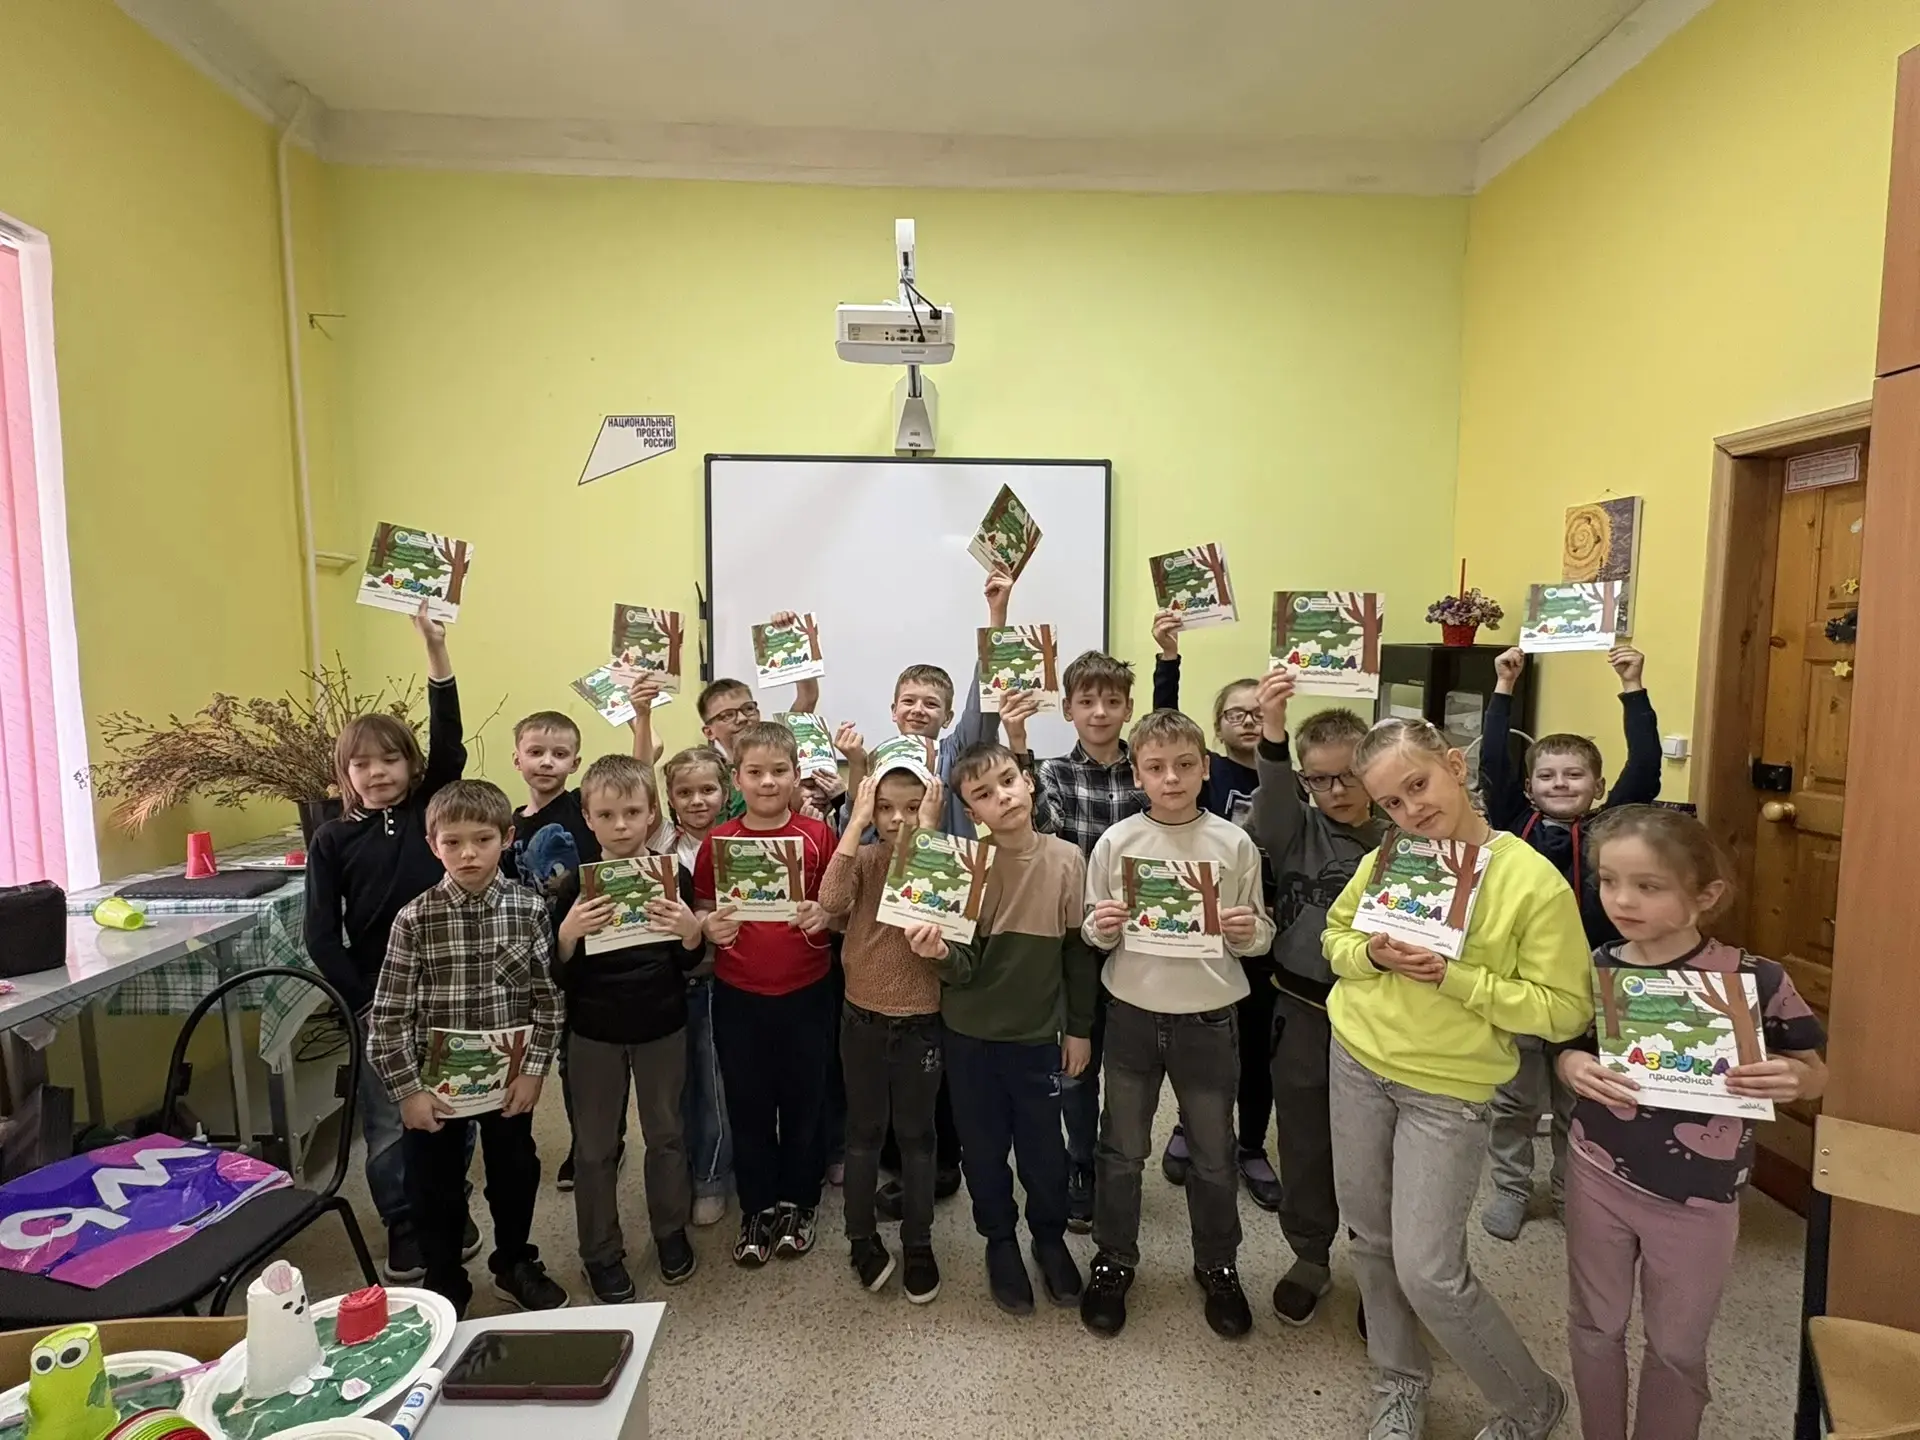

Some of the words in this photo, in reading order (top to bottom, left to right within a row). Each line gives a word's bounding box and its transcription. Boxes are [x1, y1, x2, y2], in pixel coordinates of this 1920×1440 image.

[608, 417, 673, 428] НАЦИОНАЛЬНЫЕ
[636, 428, 673, 438] ПРОЕКТЫ
[643, 438, 673, 448] РОССИИ
[381, 573, 442, 598] АЗБУКА
[1170, 594, 1218, 611] АЗБУКА
[1287, 651, 1357, 670] АЗБУКА
[991, 676, 1042, 691] АЗБУКА
[730, 887, 787, 901] АЗБУКА
[900, 885, 961, 914] АЗБУКА
[1376, 891, 1443, 921] АЗБУКА
[1139, 914, 1201, 934] АЗБУКА
[1627, 1047, 1730, 1077] АЗБУКА
[1648, 1072, 1715, 1086] природная
[437, 1079, 501, 1097] АЗБУКА
